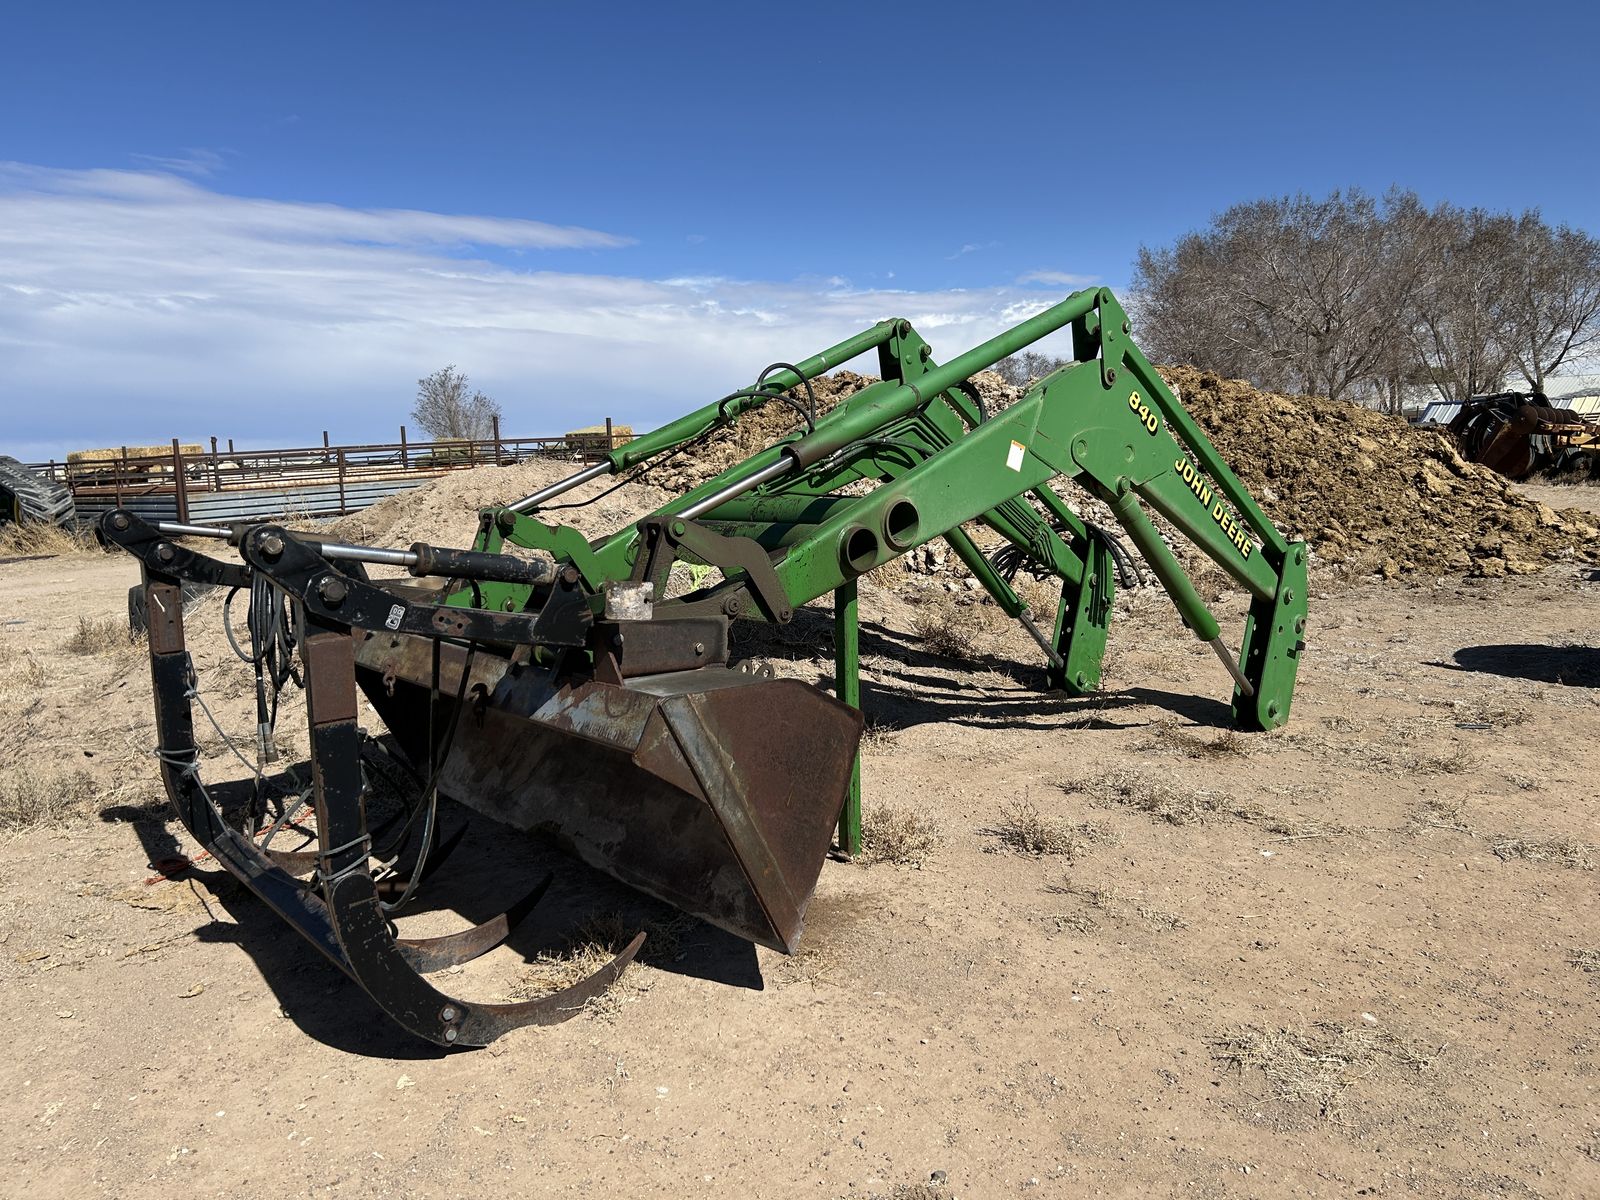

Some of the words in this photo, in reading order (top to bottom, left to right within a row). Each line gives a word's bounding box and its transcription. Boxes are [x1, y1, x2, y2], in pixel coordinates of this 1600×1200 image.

[1129, 391, 1158, 433] 840
[1174, 457, 1212, 507] JOHN
[1212, 502, 1252, 558] DEERE
